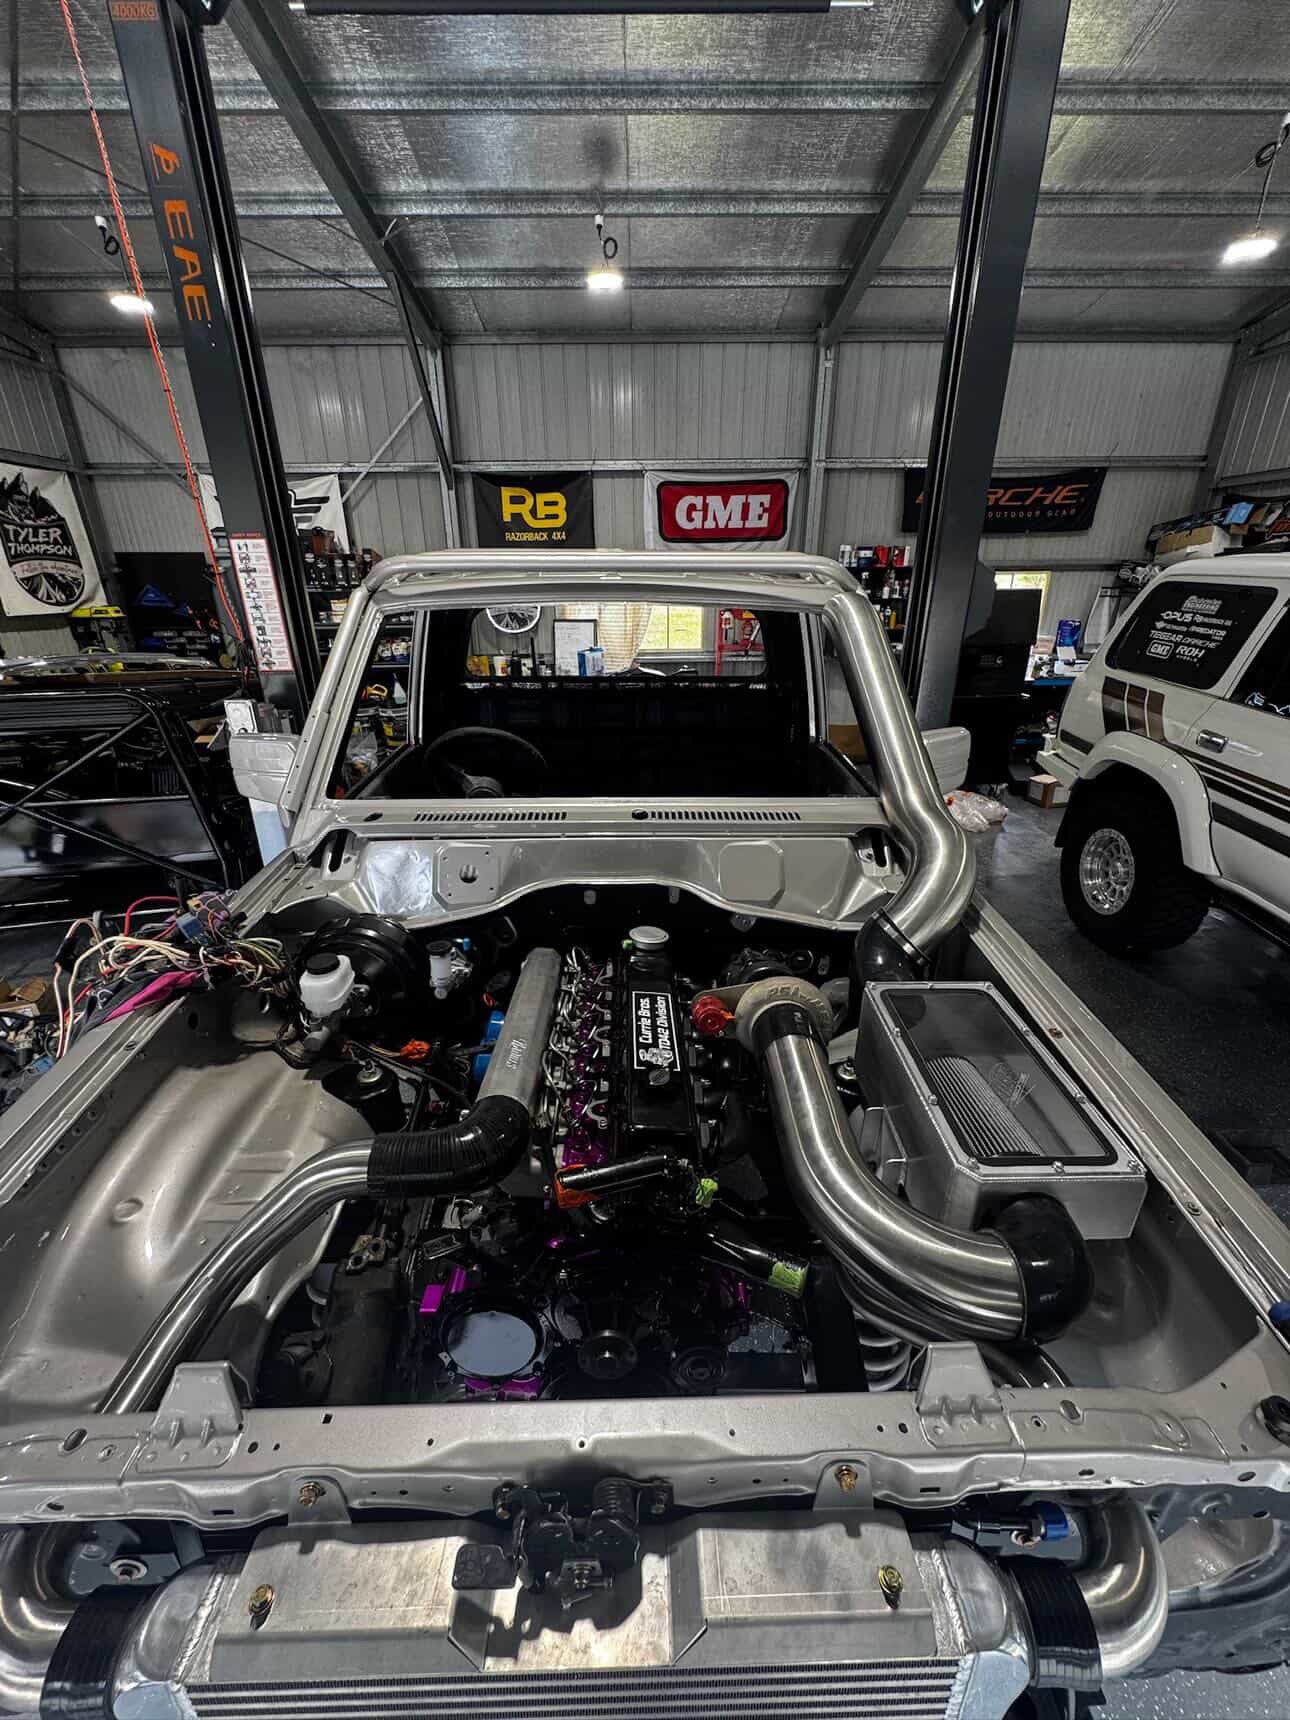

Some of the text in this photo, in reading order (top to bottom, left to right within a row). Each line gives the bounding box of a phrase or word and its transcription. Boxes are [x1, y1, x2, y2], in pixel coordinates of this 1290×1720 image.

[163, 199, 211, 321] EAE
[500, 486, 568, 529] RB
[675, 494, 771, 530] GME
[3, 524, 63, 544] TYLER
[8, 543, 72, 556] THOMPSON
[504, 531, 566, 543] RAZORBACK 4X4
[1176, 645, 1206, 658] ROH
[637, 997, 653, 1043] Currie Bros.
[655, 996, 671, 1050] TD42 Division
